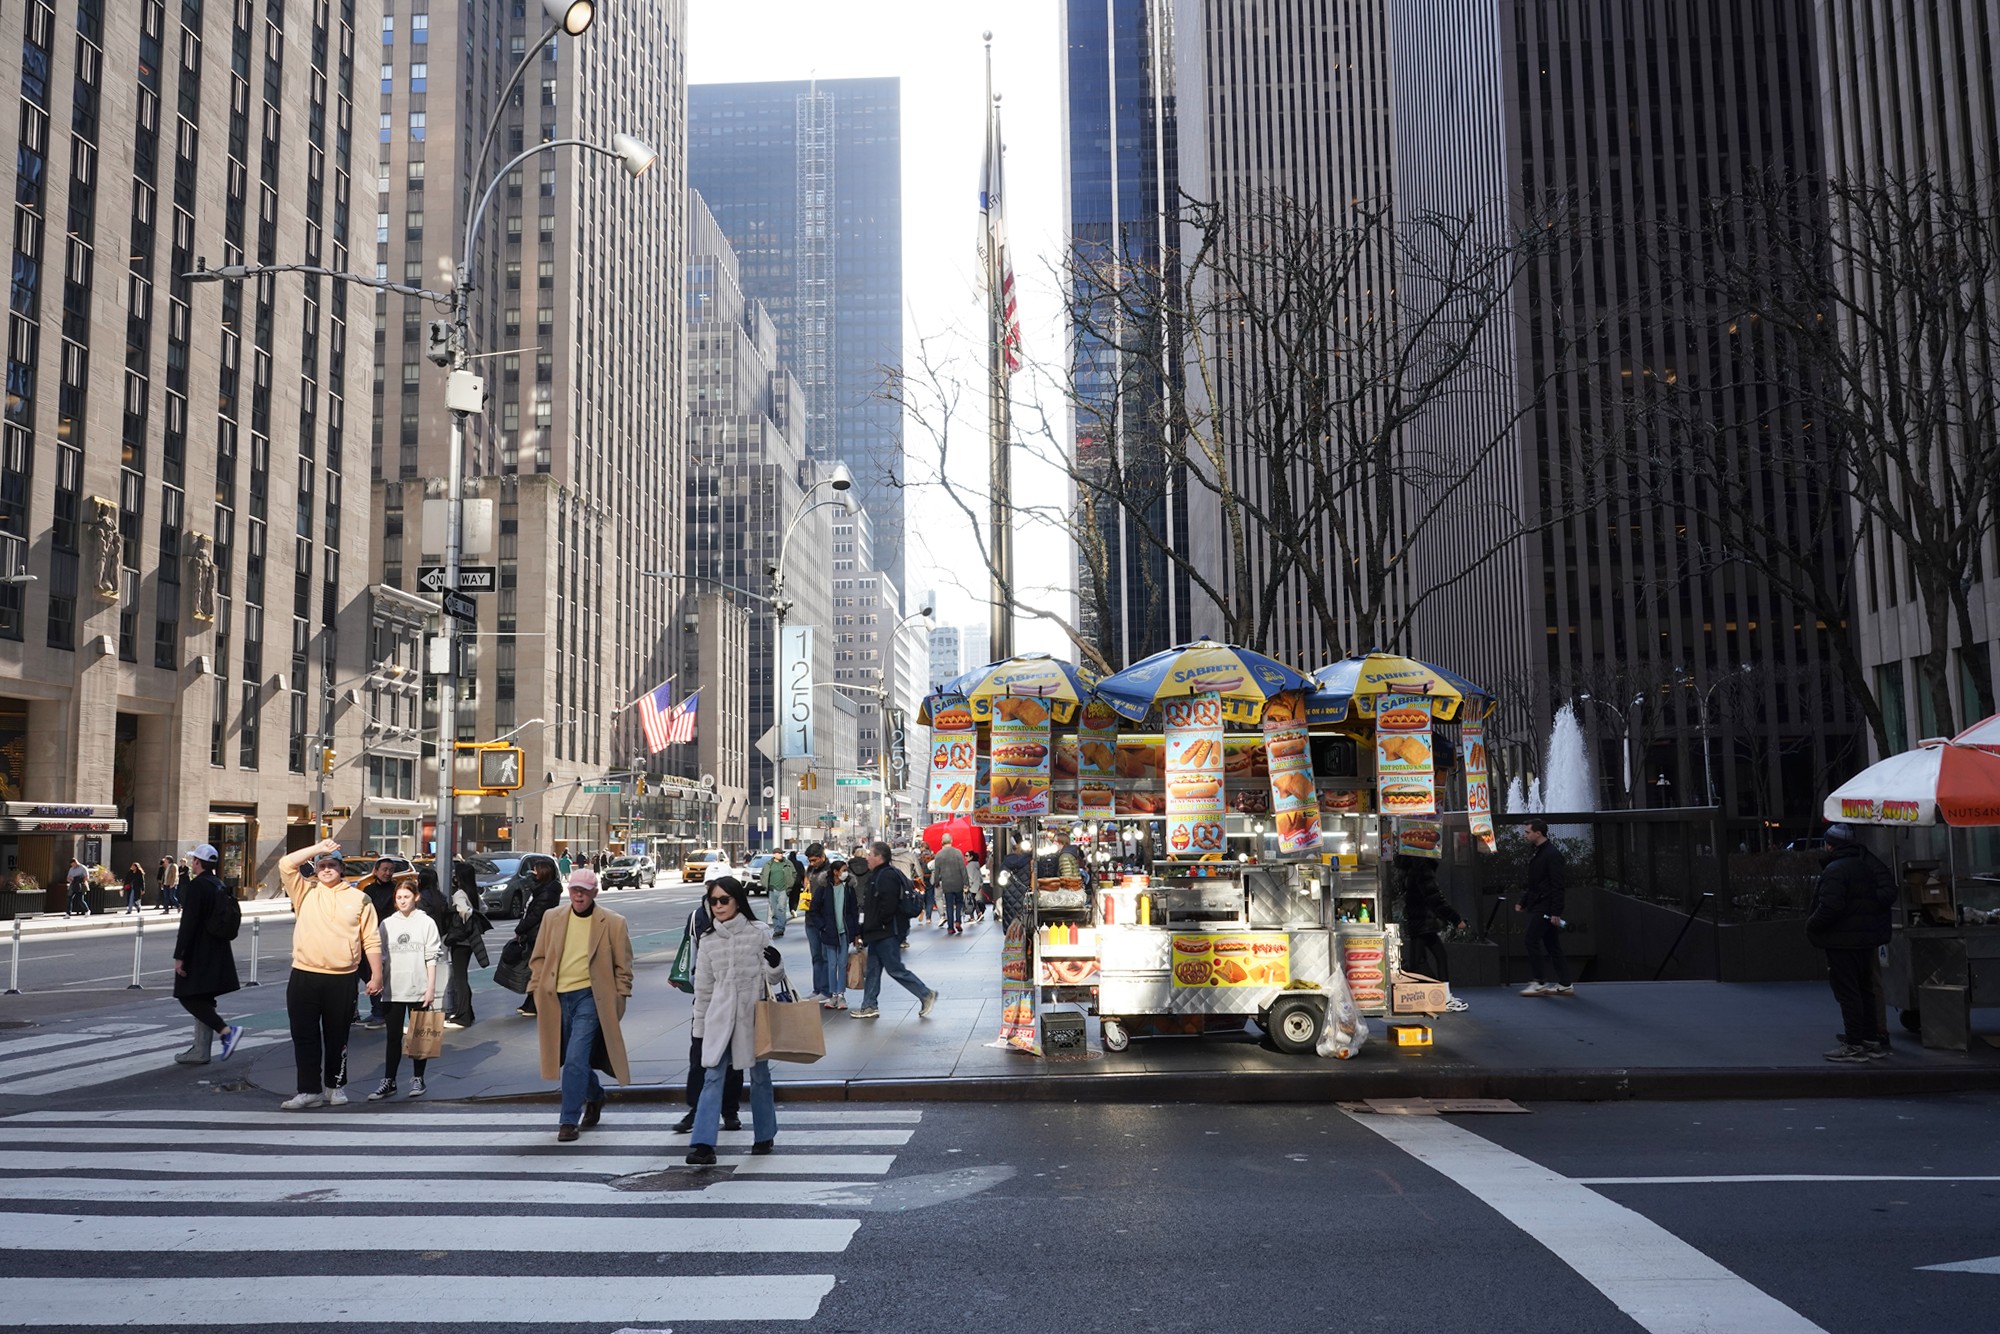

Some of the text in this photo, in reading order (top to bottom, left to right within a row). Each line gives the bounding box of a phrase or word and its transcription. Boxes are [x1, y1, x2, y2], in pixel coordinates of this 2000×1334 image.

[429, 575, 485, 584] ON WAY
[448, 597, 473, 614] ONE WAY
[993, 672, 1057, 686] SABRETT
[1174, 664, 1238, 682] SABRETT
[1365, 671, 1424, 683] SABRETT
[791, 630, 810, 754] 1251
[1381, 695, 1431, 712] SABRETT
[891, 710, 905, 790] 1251
[992, 801, 1045, 813] BEEF Patties
[1842, 799, 1919, 821] NUTS4NUTS
[1401, 992, 1425, 1003] Pretzel
